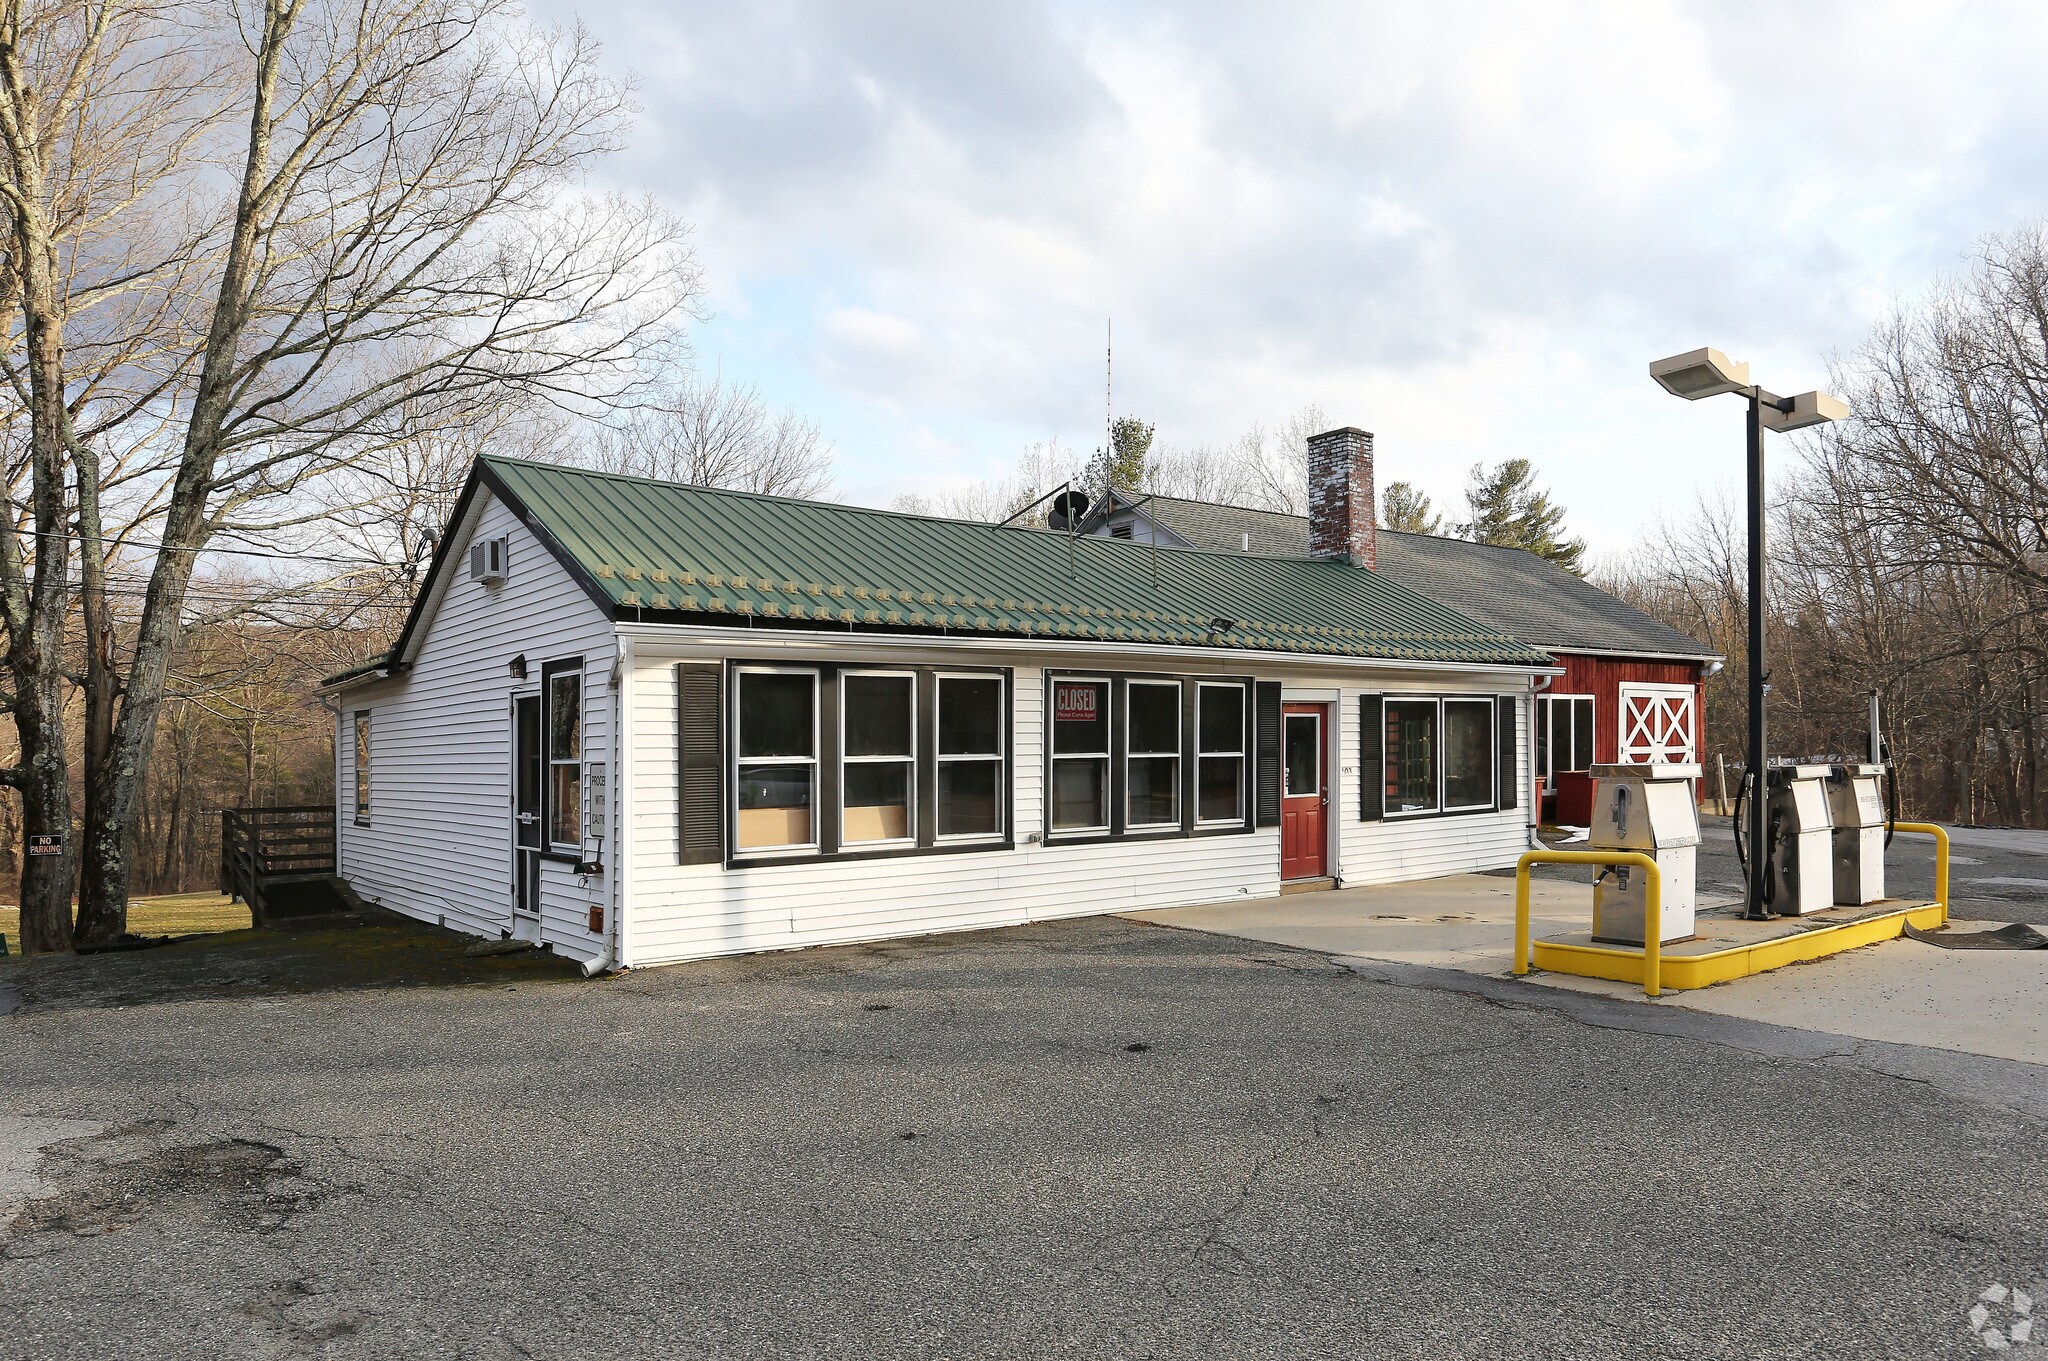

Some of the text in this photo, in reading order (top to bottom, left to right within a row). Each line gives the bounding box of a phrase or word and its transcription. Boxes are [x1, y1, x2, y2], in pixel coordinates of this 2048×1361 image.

[1058, 689, 1095, 711] CLOSED
[39, 837, 51, 845] NO
[30, 845, 61, 853] PARKING
